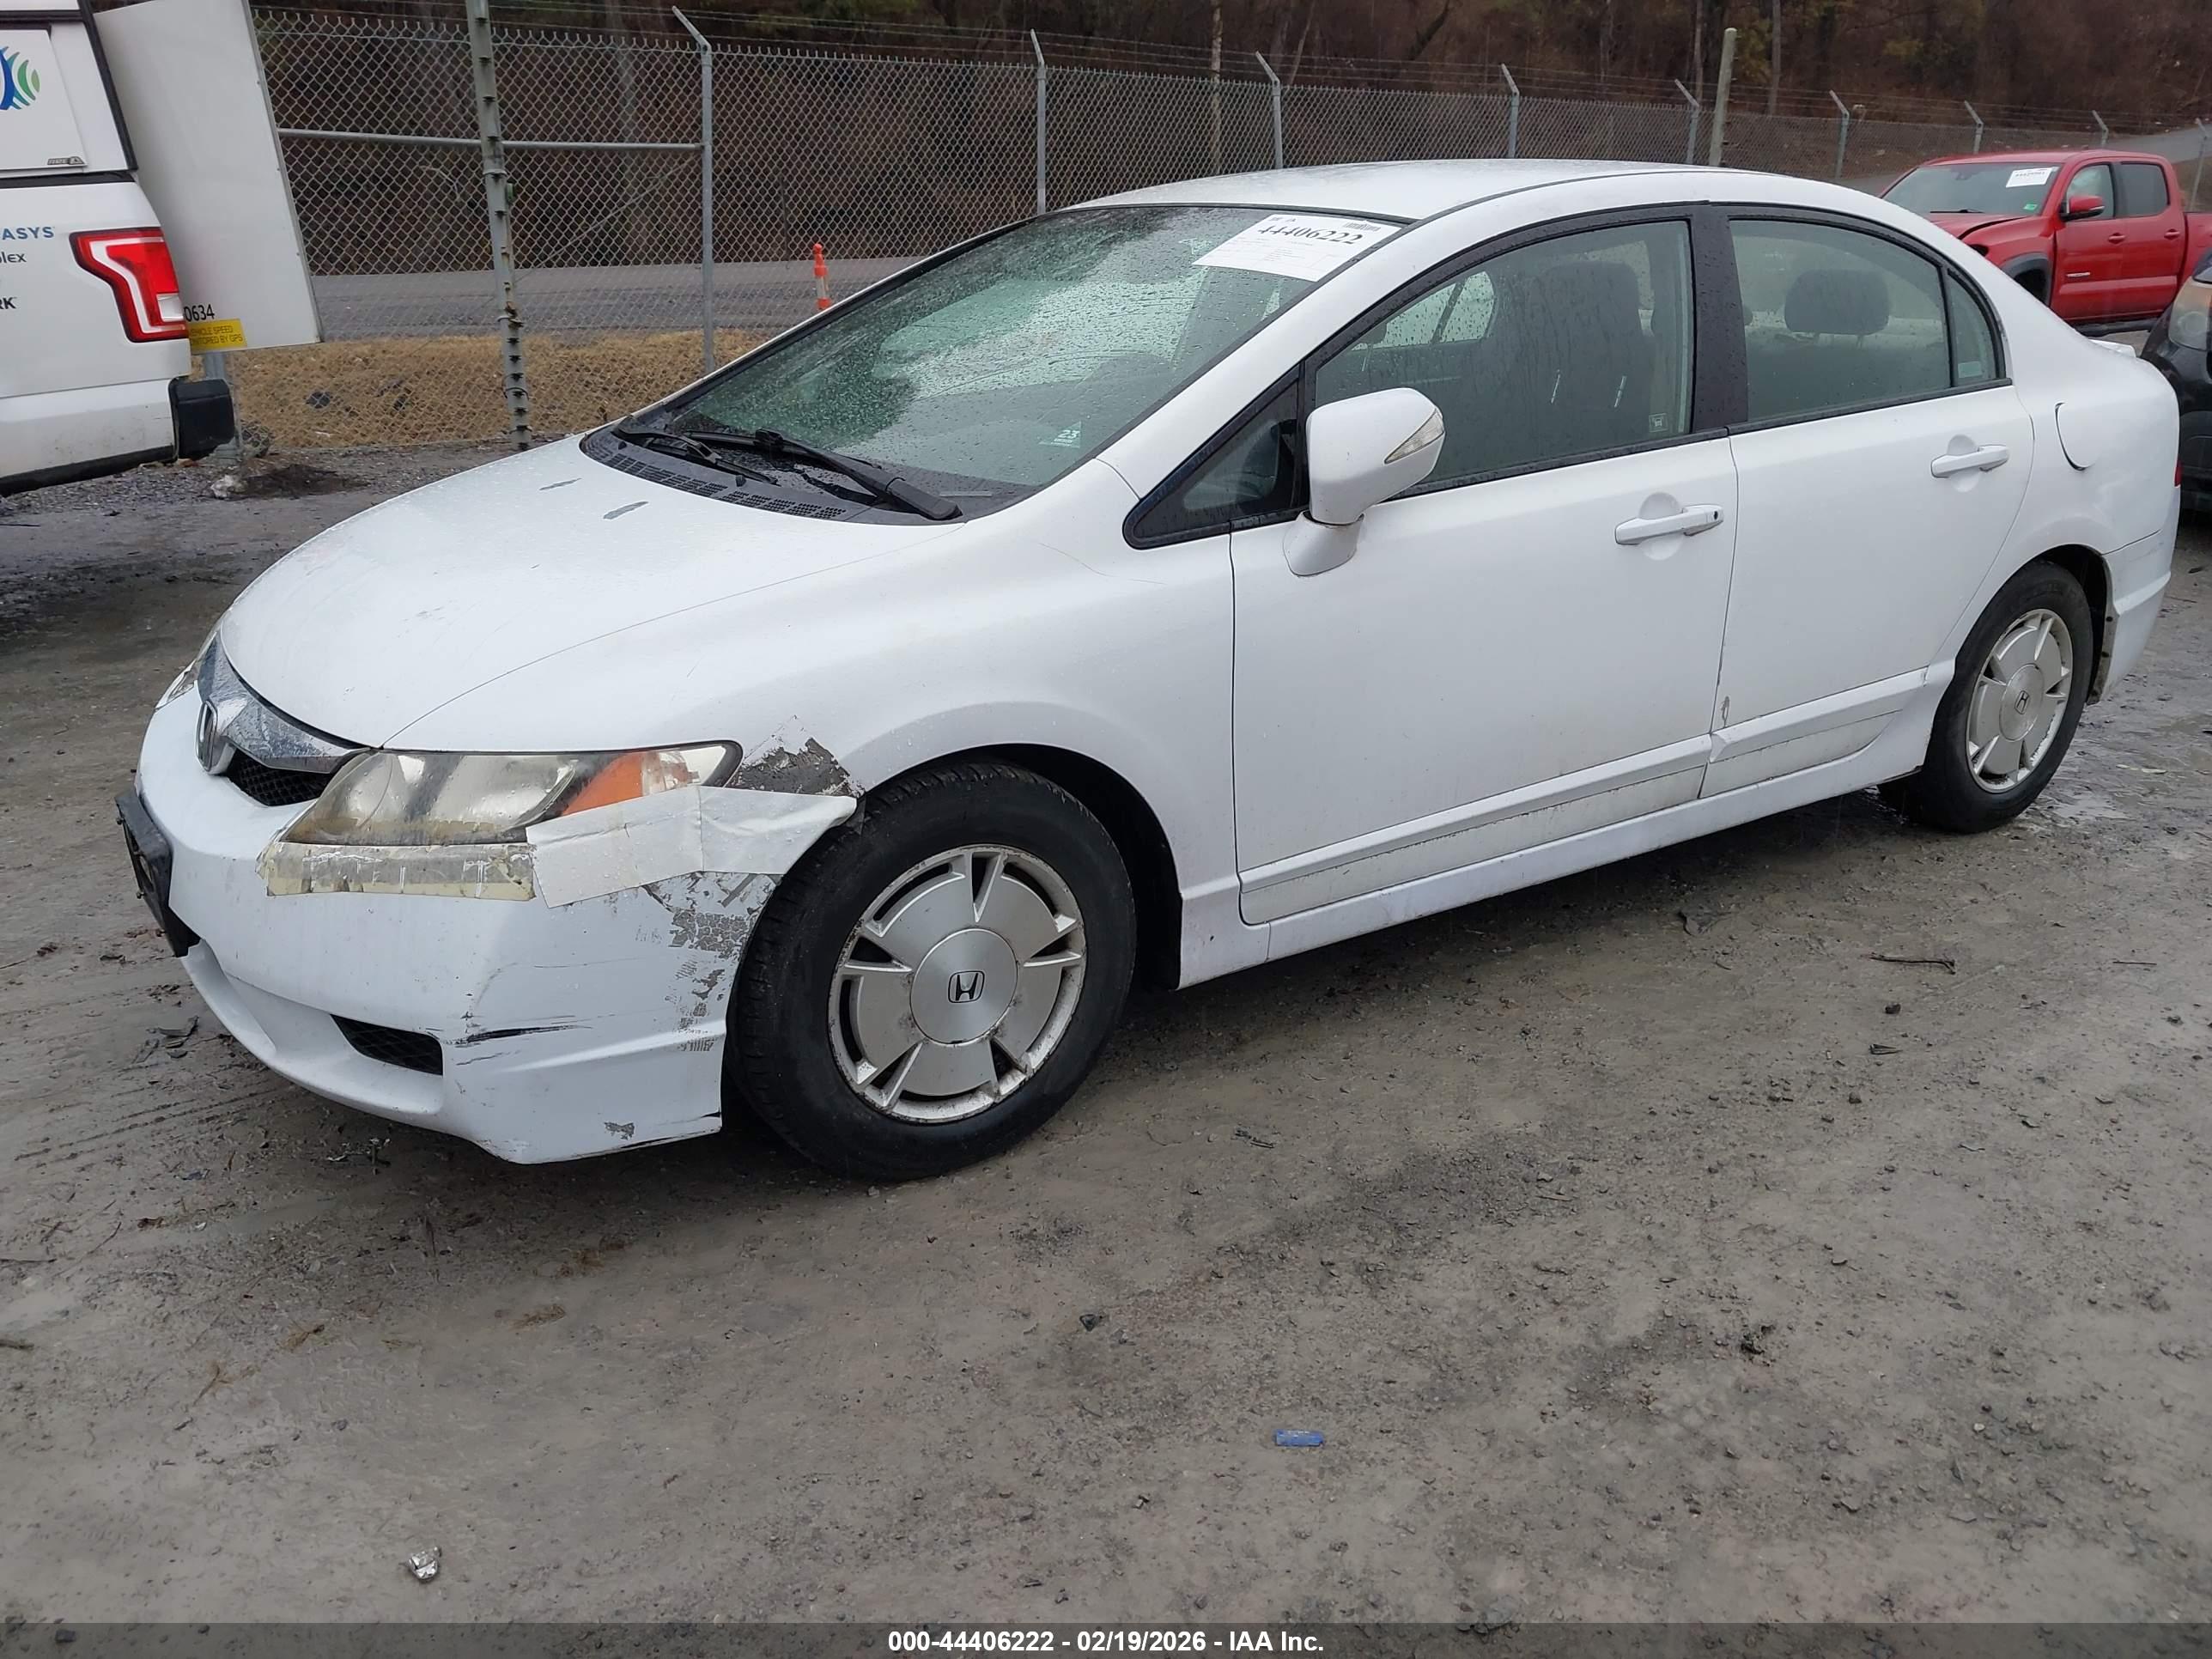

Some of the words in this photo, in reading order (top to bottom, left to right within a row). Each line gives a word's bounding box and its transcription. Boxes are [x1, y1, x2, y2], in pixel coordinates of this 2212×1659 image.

[3, 227, 54, 240] ASYS
[1258, 225, 1363, 244] 44406222
[0, 252, 27, 264] lex
[183, 304, 215, 322] 0634
